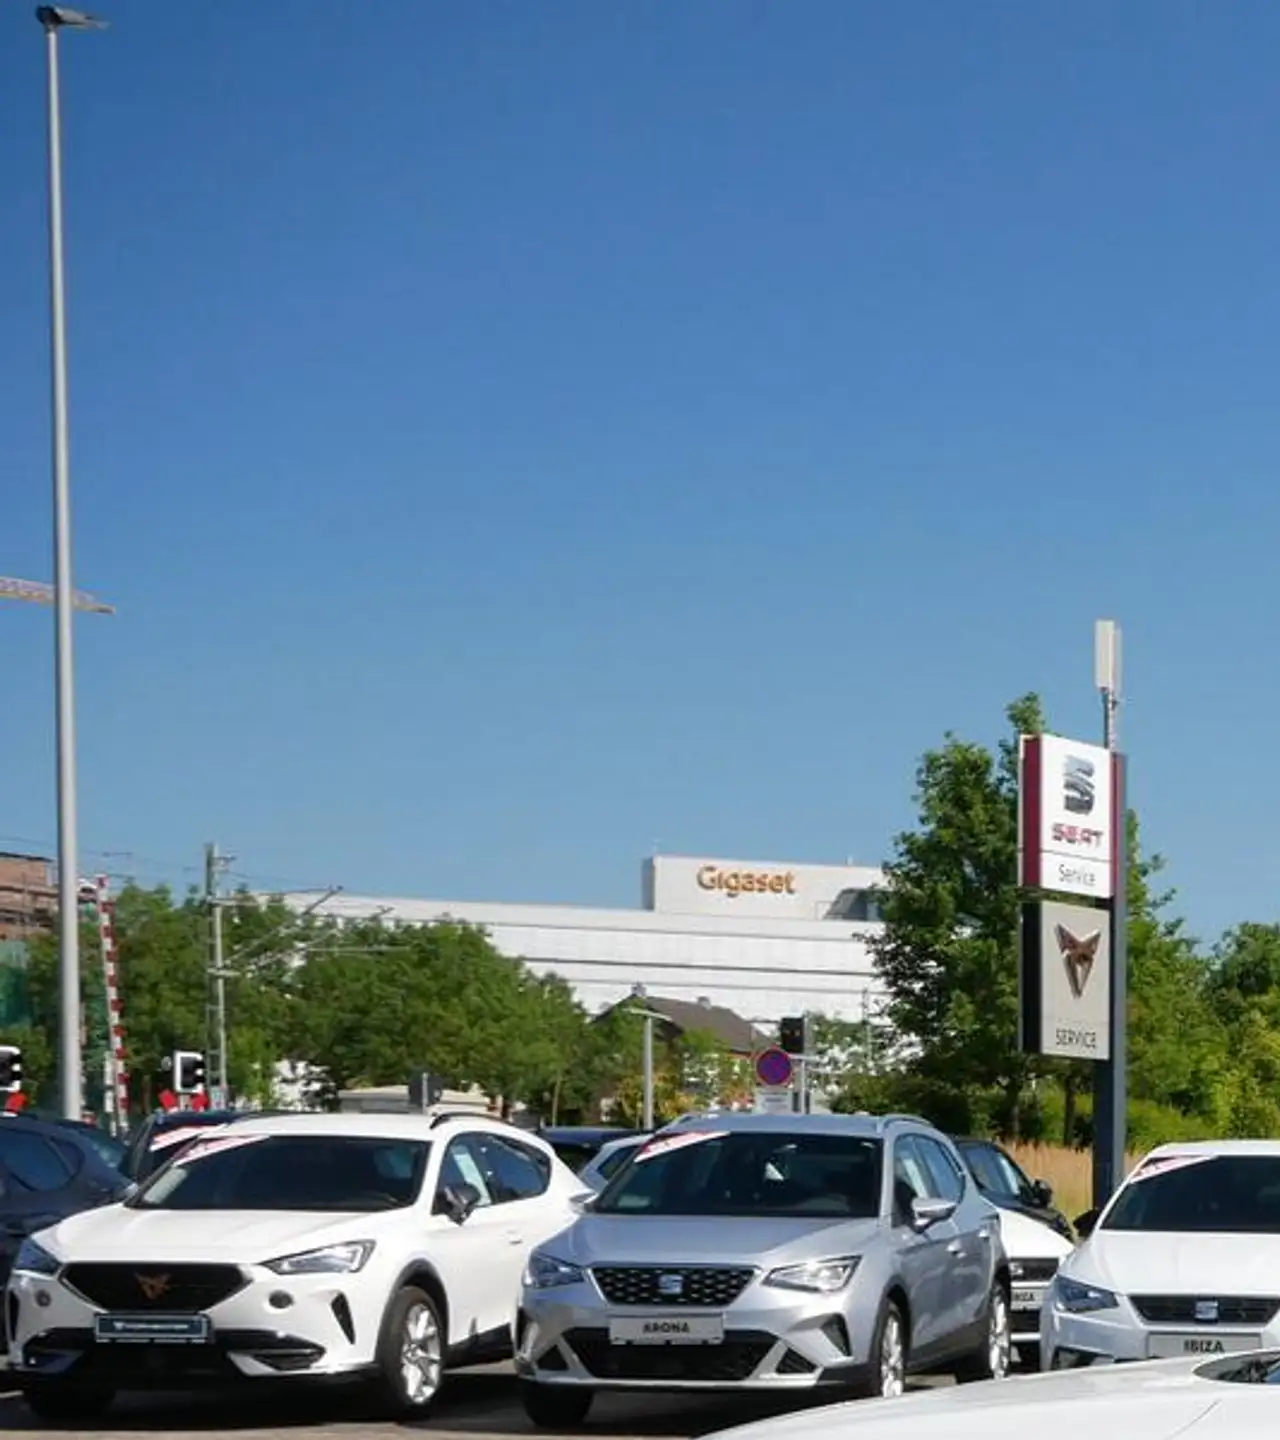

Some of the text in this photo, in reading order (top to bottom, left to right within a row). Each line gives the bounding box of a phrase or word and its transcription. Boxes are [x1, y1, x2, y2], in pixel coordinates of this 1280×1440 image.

[1052, 822, 1103, 846] SEAT
[696, 865, 794, 898] Gigaset
[1058, 863, 1096, 886] Service
[1055, 1028, 1096, 1048] SERVICE
[643, 1321, 690, 1333] ARONA
[1183, 1339, 1225, 1352] IBIZA
